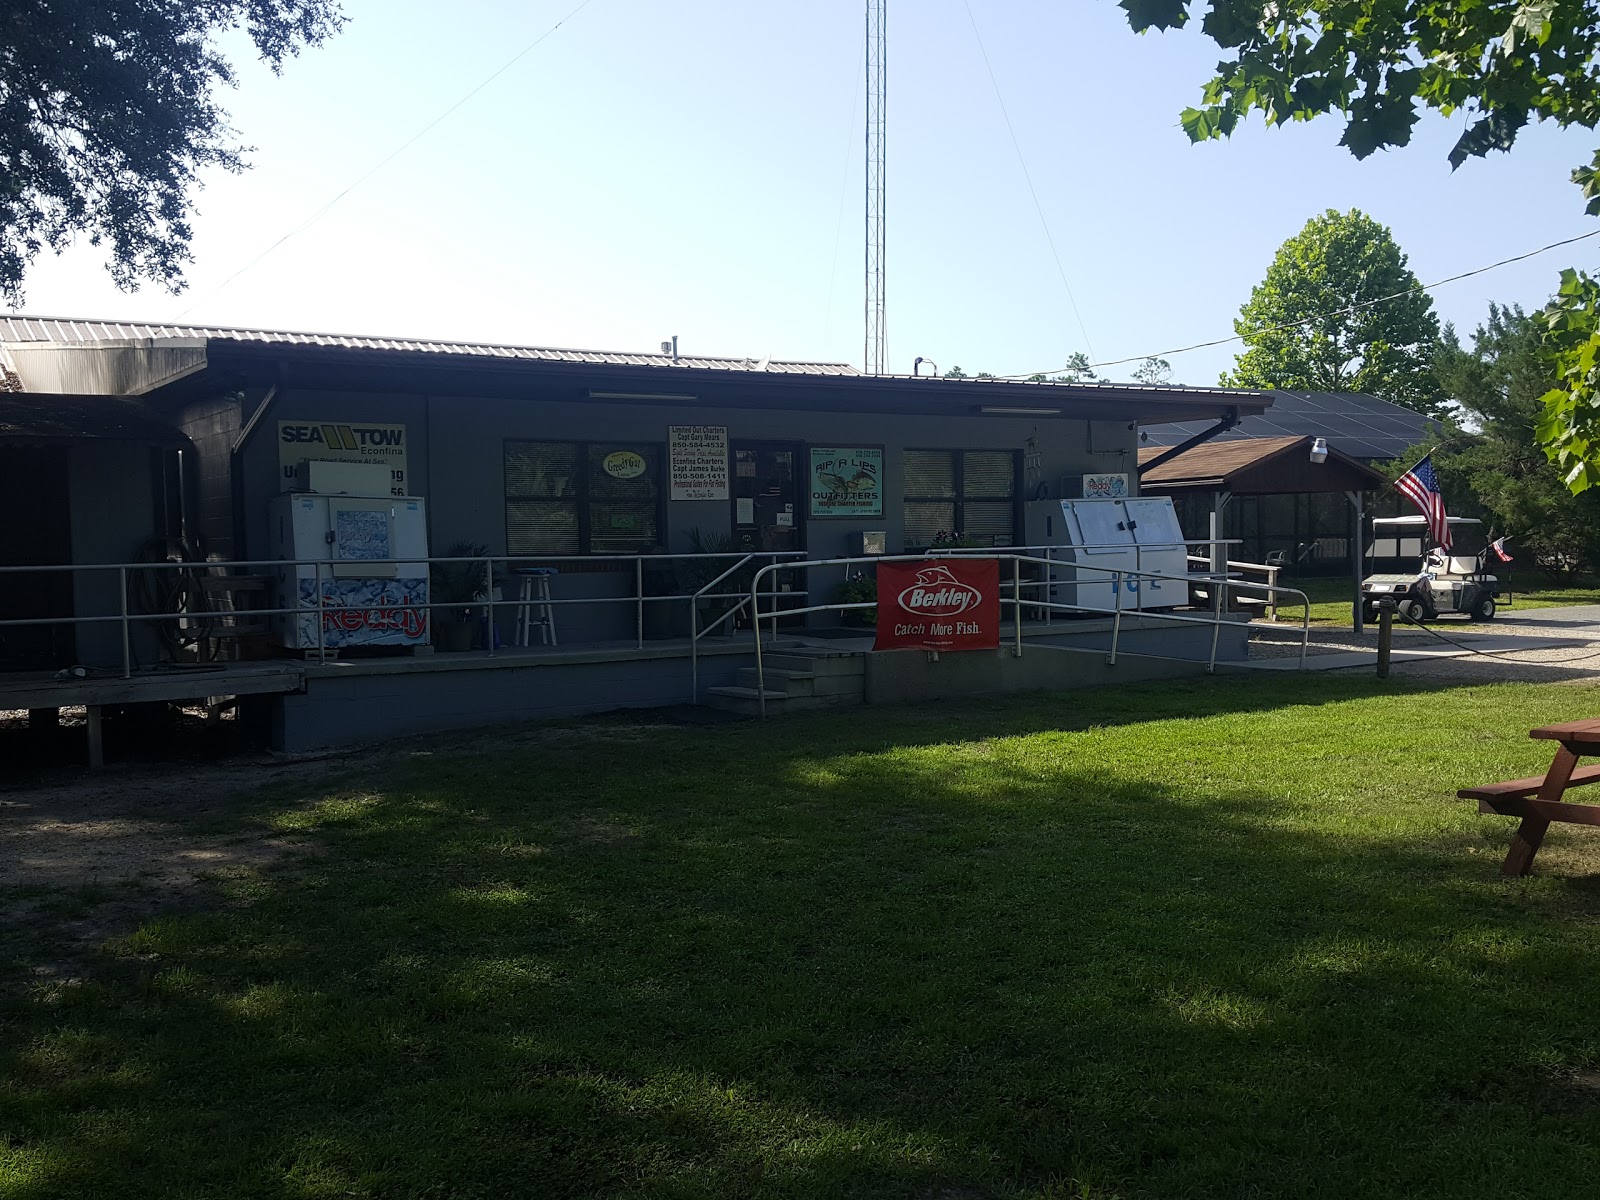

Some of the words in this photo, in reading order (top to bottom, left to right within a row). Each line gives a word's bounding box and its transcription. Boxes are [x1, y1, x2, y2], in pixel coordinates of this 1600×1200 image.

[672, 426, 691, 434] Limited
[693, 426, 702, 434] Out
[703, 426, 725, 434] Charters
[281, 425, 324, 443] SEA
[352, 428, 403, 446] TOW
[677, 433, 690, 442] Capt
[691, 433, 703, 442] Gary
[704, 433, 720, 441] Mears
[361, 447, 403, 455] Econfina
[672, 457, 696, 465] Econfina
[697, 457, 724, 465] Charters
[672, 464, 687, 473] Capt
[815, 460, 834, 474] RIP
[838, 458, 847, 469] A
[851, 458, 877, 475] LIPS
[1089, 482, 1110, 491] Reddy
[812, 492, 878, 500] OUTFITTERS
[909, 588, 973, 614] Berkley
[322, 595, 427, 638] Reddy
[894, 623, 925, 636] Catch
[930, 623, 953, 636] More
